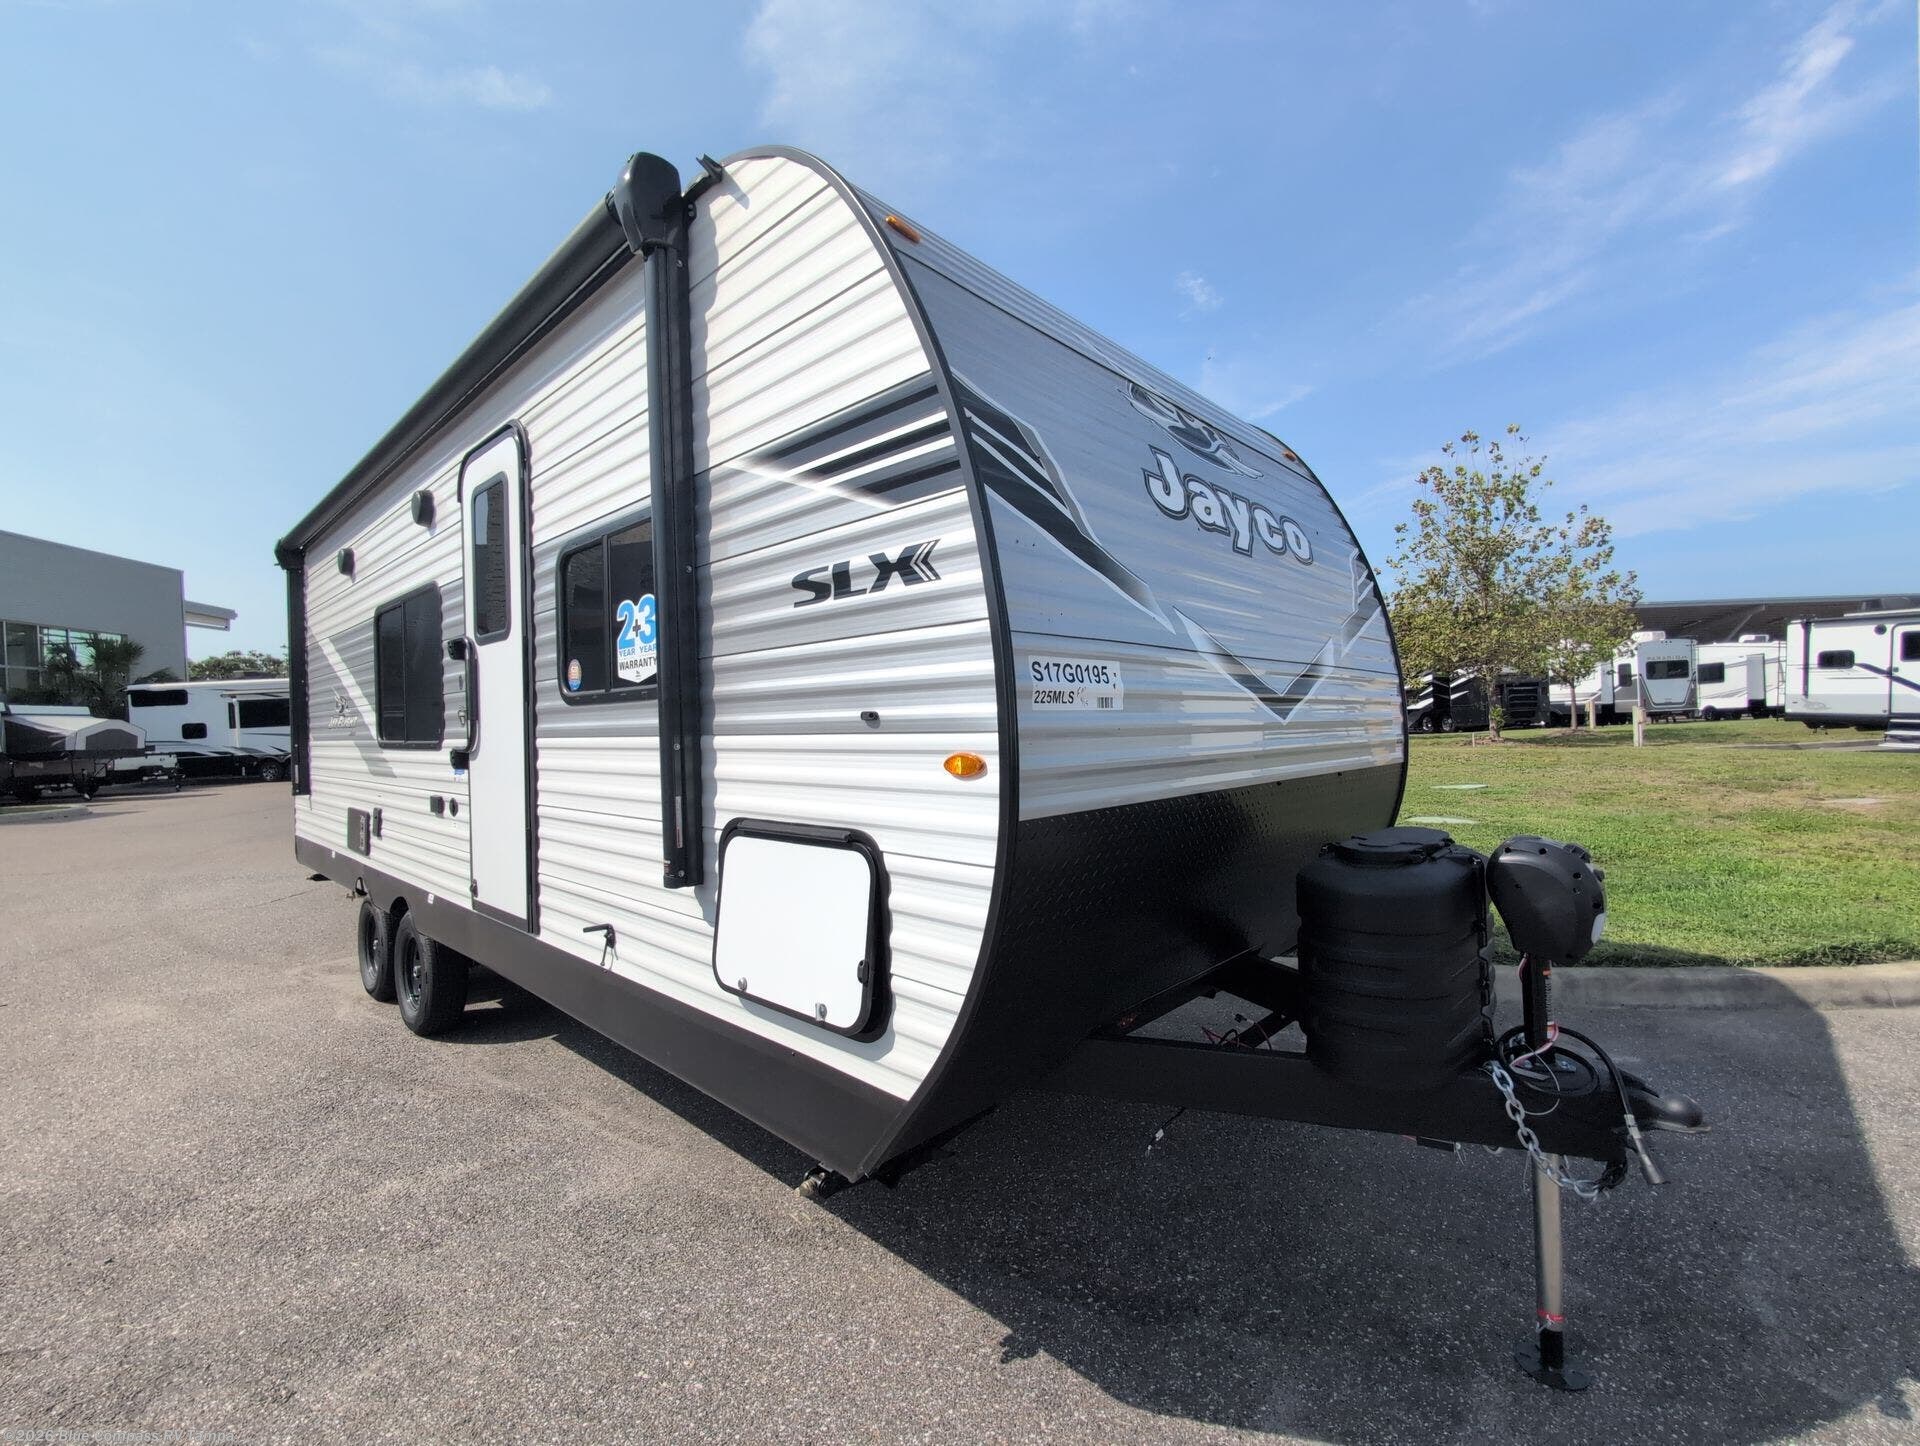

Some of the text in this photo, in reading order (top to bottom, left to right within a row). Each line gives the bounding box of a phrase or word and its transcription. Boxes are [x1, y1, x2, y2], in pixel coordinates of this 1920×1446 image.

[1141, 444, 1314, 566] Jayco
[791, 538, 942, 608] SLX
[619, 647, 636, 657] YEAR
[619, 656, 656, 671] WARRANTY
[1031, 661, 1110, 684] S17G0195
[1033, 690, 1075, 704] 225MLS
